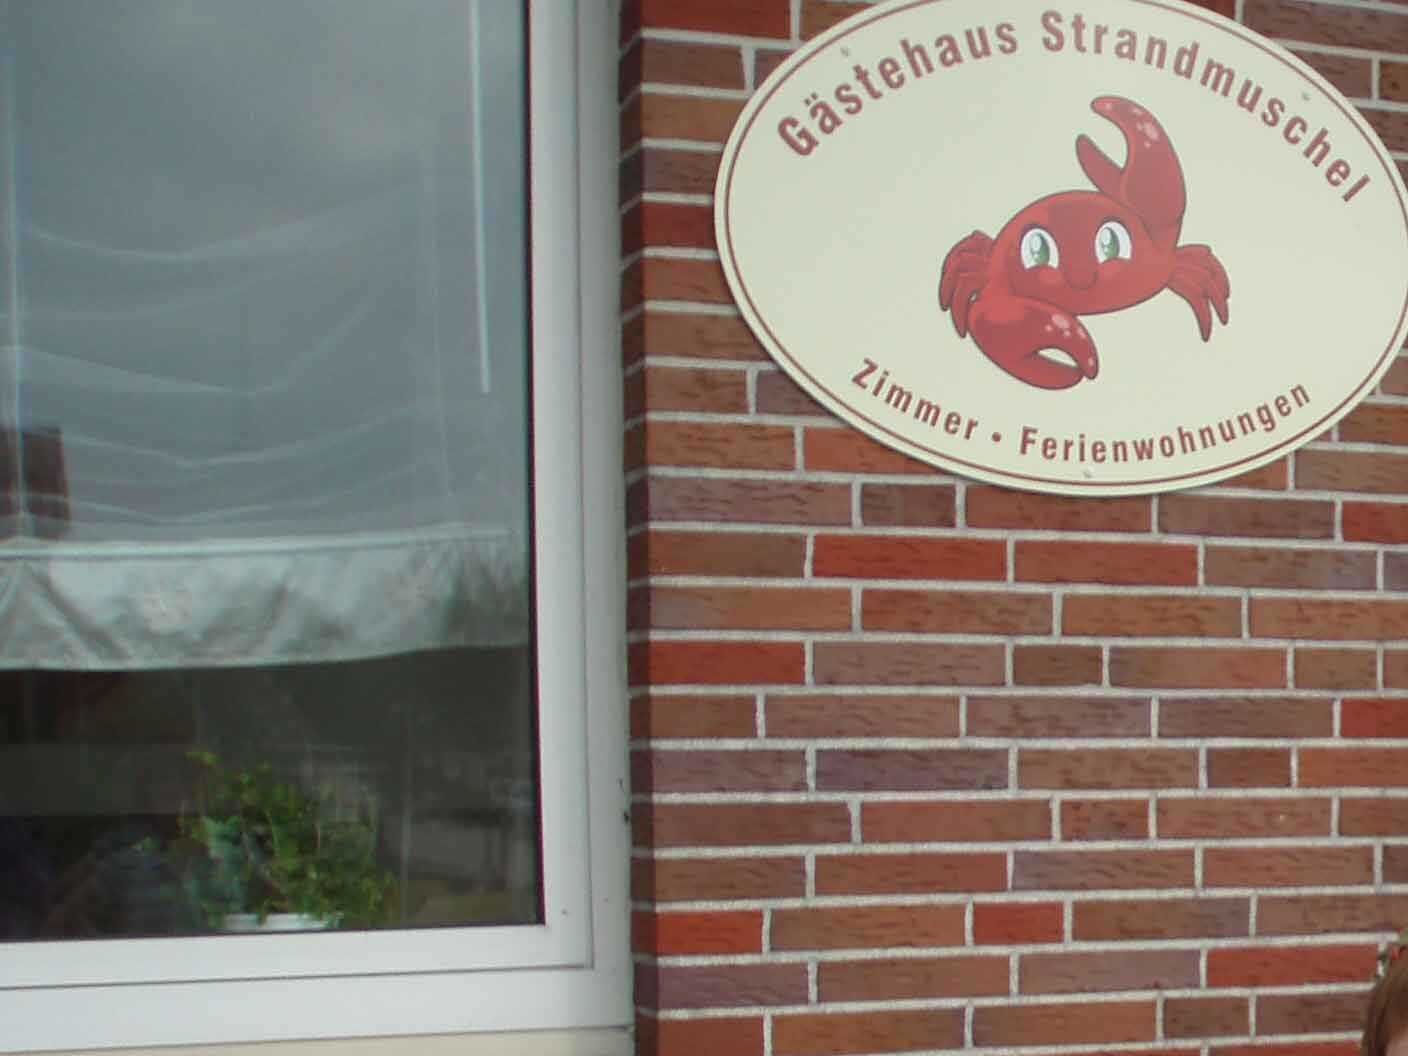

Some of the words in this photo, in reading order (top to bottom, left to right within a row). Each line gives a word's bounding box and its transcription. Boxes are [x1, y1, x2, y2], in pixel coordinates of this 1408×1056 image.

[777, 21, 1018, 156] Gästehaus
[1040, 9, 1371, 203] Strandmuschel
[850, 356, 980, 442] Zimmer
[1018, 382, 1313, 464] Ferienwohnungen
